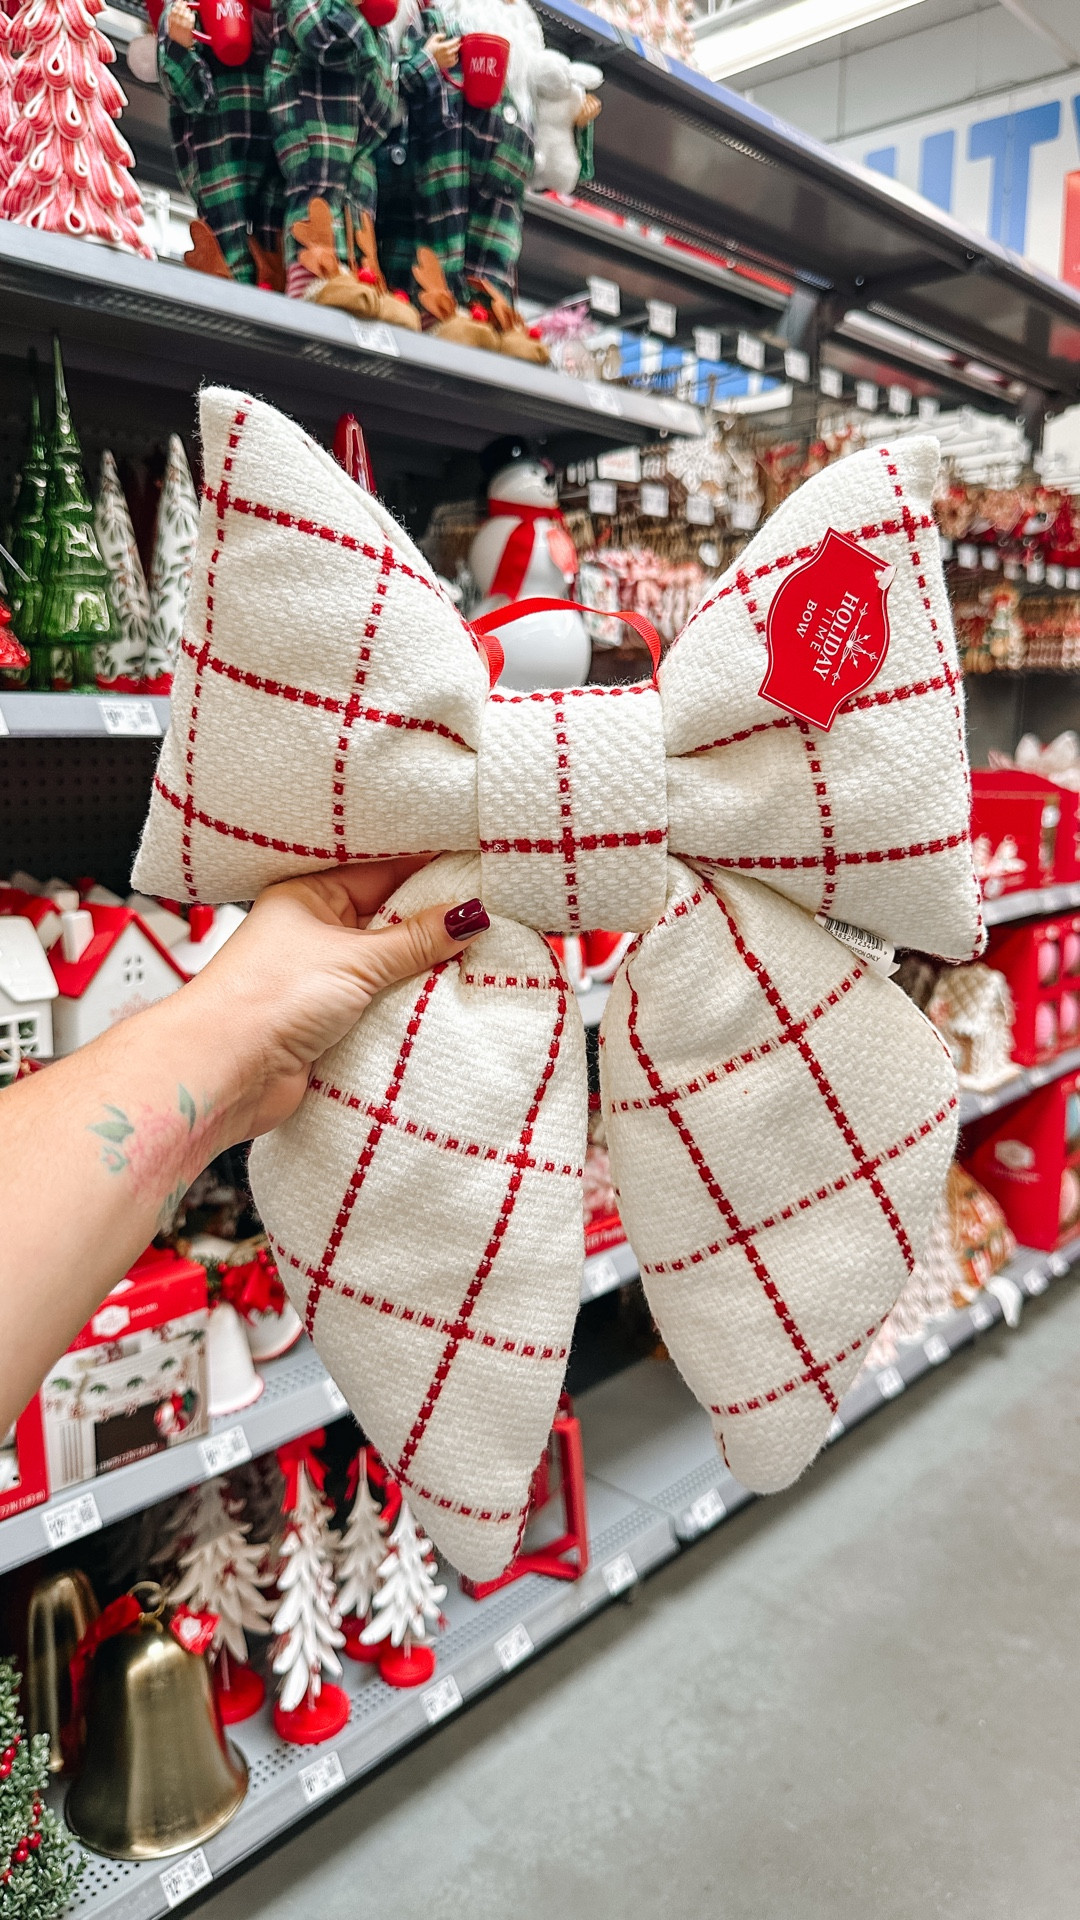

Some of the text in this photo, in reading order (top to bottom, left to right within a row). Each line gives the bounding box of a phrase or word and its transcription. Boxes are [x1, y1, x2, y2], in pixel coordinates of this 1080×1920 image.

[216, 1, 246, 21] MR
[796, 599, 818, 638] BOW
[810, 608, 837, 651] TIME
[813, 591, 860, 681] HOLIDAY
